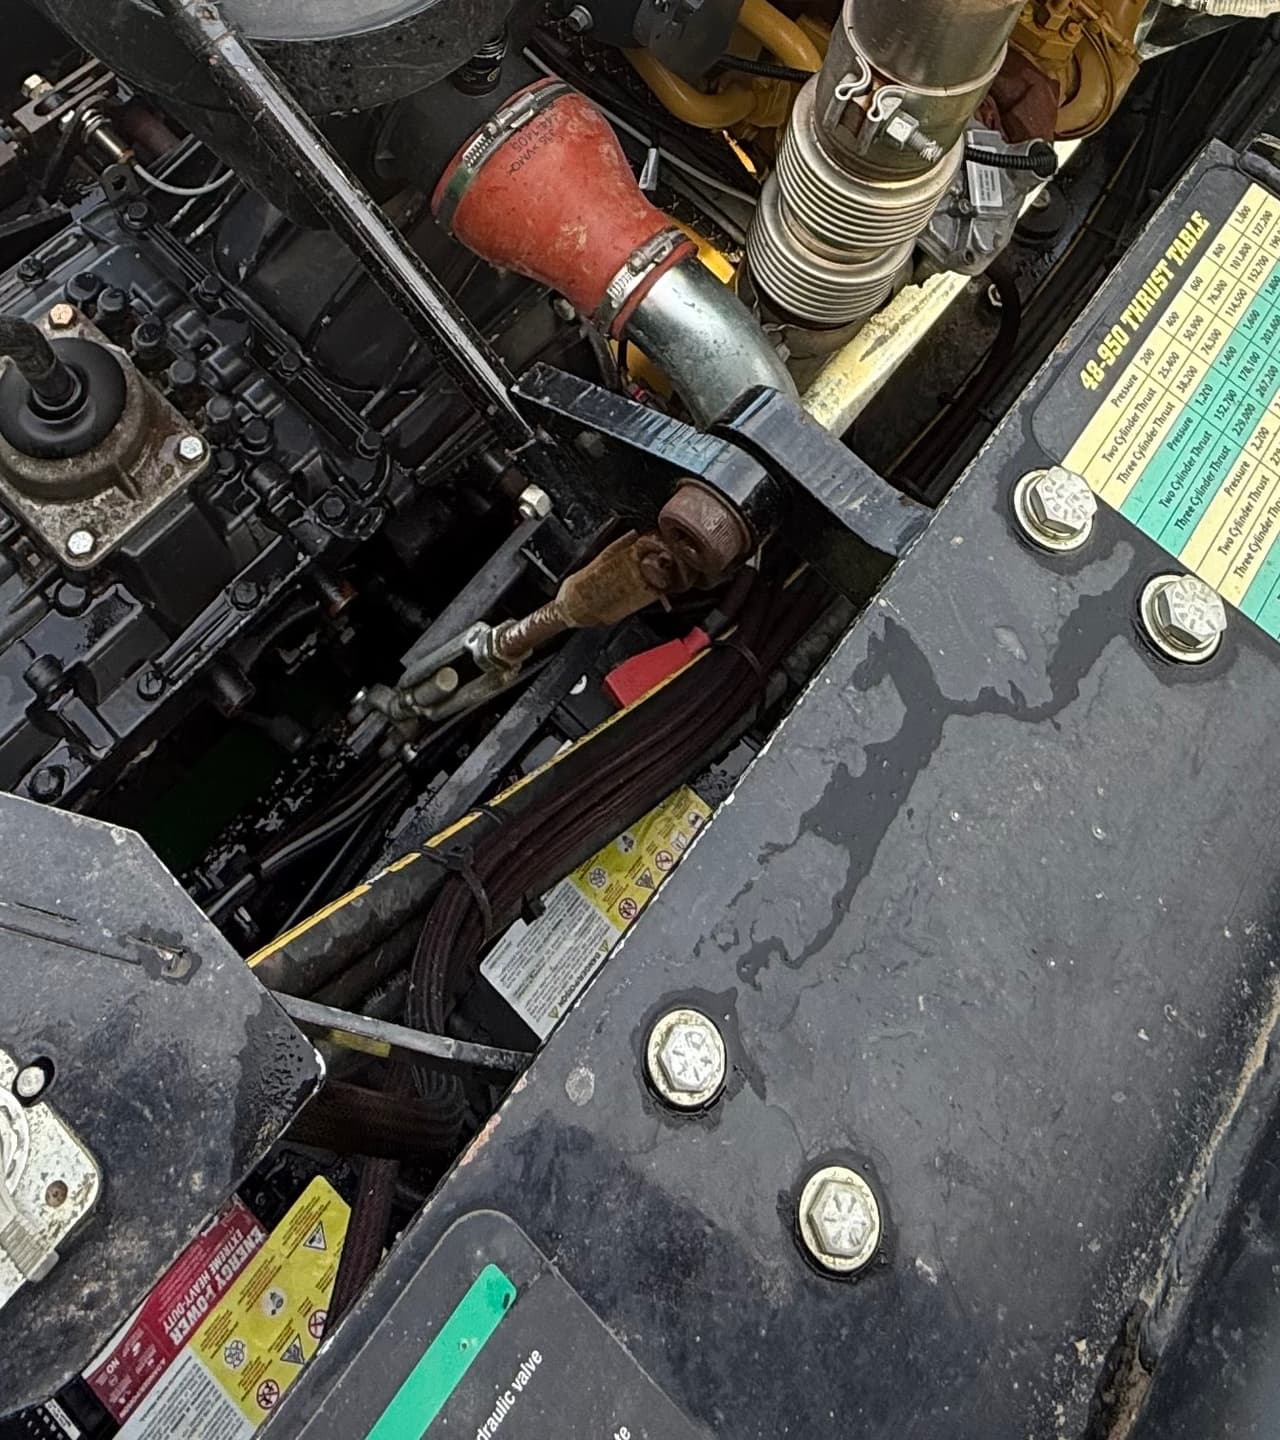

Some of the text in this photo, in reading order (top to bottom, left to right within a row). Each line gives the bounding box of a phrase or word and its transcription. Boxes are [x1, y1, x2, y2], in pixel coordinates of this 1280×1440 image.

[1080, 210, 1210, 391] 48-950 THRUST TABLE
[1101, 444, 1119, 463] Two
[1113, 411, 1140, 446] Cylinder
[1133, 387, 1158, 414] Thrust
[1110, 373, 1139, 409] Pressure
[1115, 459, 1138, 485] Three
[1132, 426, 1159, 461] Cylinder
[1152, 401, 1176, 428] Thrust
[1166, 416, 1194, 452] Pressure
[1158, 490, 1176, 509] Two
[1170, 455, 1197, 491] Cylinder
[1189, 430, 1213, 458] Thrust
[1173, 505, 1196, 531] Three
[1189, 470, 1216, 506] Cylinder
[1208, 445, 1232, 473] Thrust
[1223, 460, 1251, 498] Pressure
[1216, 536, 1235, 556] Two
[1228, 501, 1254, 538] Cylinder
[1247, 474, 1270, 503] Thrust
[1232, 552, 1255, 579] Three
[1247, 516, 1274, 554] Cylinder
[208, 1228, 244, 1274] EXTREME
[511, 1349, 543, 1393] valve
